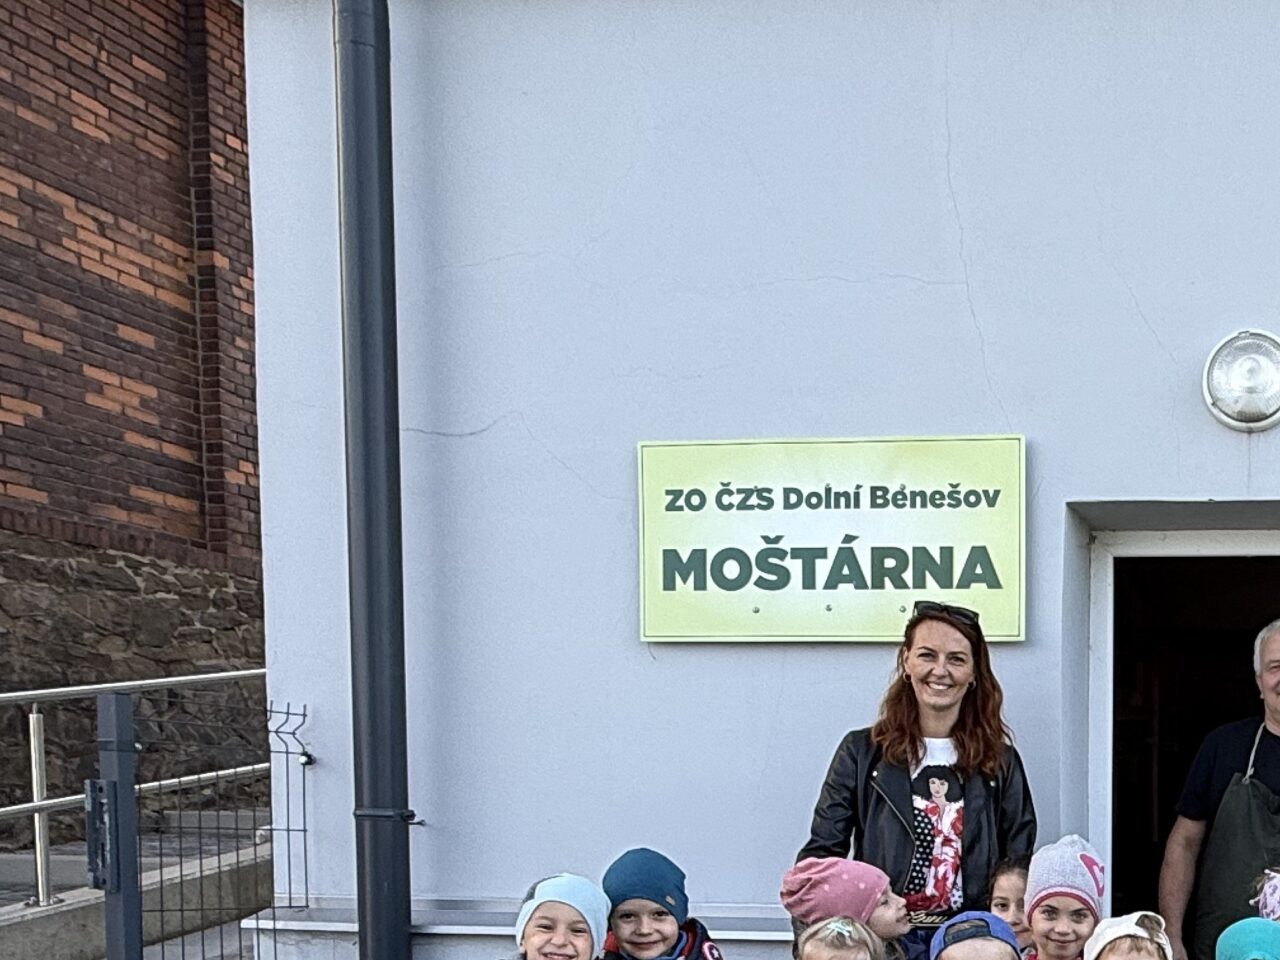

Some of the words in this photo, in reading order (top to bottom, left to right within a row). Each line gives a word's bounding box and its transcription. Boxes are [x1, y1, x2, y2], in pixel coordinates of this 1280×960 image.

[665, 488, 707, 512] ZO
[715, 482, 775, 511] ČZS
[783, 484, 863, 510] Dolní
[662, 534, 1003, 591] MOŠTÁRNA
